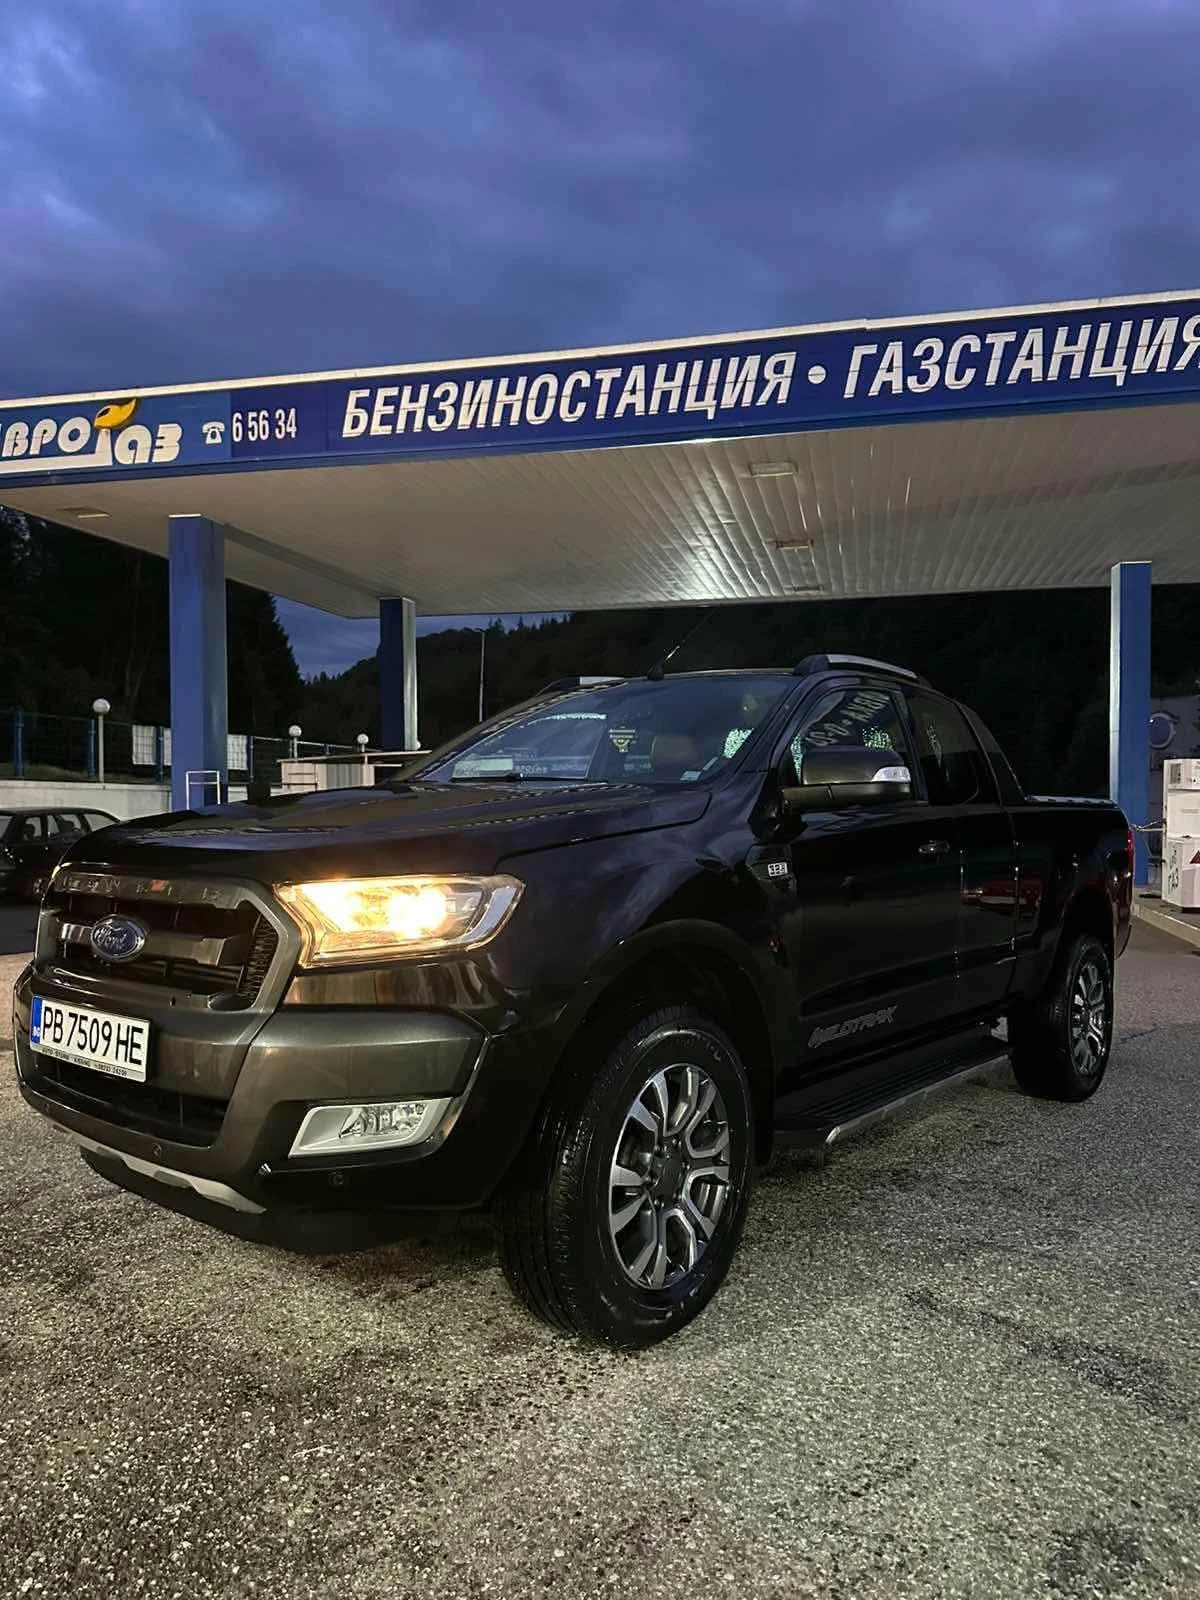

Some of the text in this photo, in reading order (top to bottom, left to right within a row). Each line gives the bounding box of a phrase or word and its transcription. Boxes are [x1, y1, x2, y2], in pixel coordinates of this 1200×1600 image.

[232, 408, 297, 442] 6 56 34
[342, 351, 797, 439] БЕНЗИНОСТАНЦИЯ
[42, 1006, 144, 1066] PB 7509 HE
